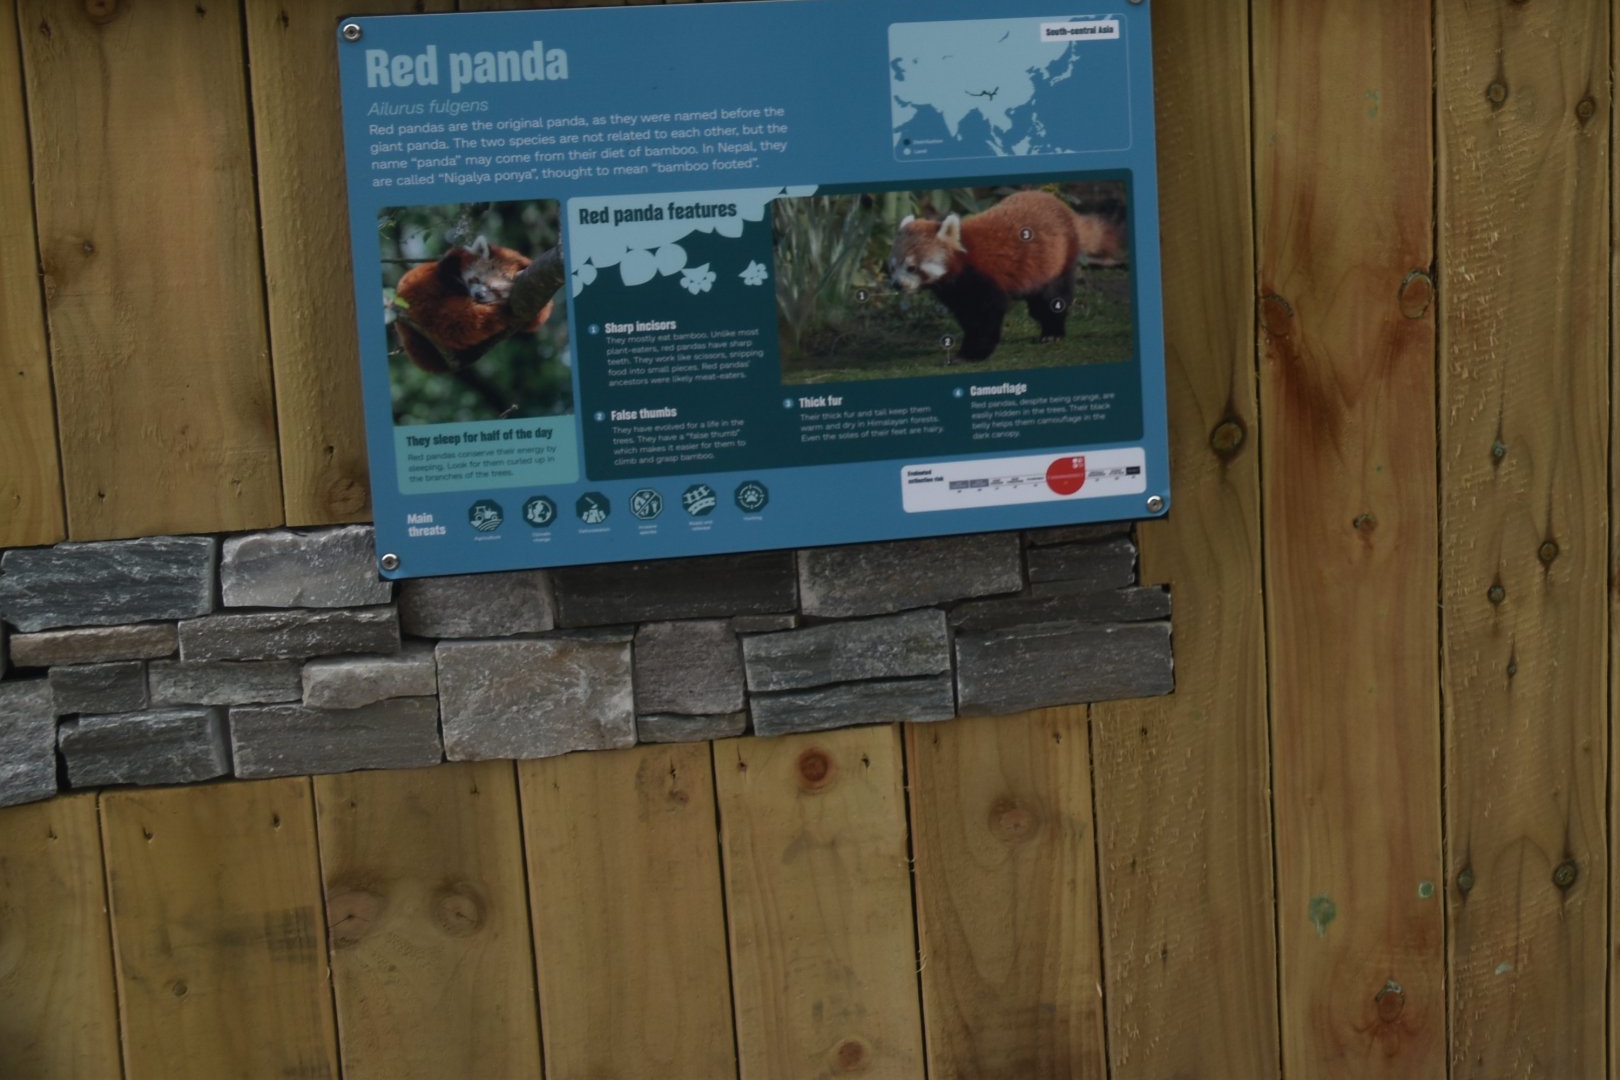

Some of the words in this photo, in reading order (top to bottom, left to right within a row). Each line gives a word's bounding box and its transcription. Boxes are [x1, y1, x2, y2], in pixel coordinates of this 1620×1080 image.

[1098, 25, 1114, 34] Asia
[364, 44, 440, 88] Red
[447, 39, 570, 94] panda
[366, 101, 424, 117] Ailurus
[429, 98, 489, 117] fulgens
[369, 124, 394, 136] Red
[398, 121, 445, 138] pandas
[448, 123, 468, 132] are
[472, 119, 493, 131] the
[497, 117, 543, 133] original
[546, 114, 589, 130] panda,
[592, 116, 606, 125] as
[610, 112, 637, 127] they
[641, 113, 671, 123] were
[674, 108, 717, 121] named
[721, 106, 760, 119] before
[764, 105, 785, 117] the
[369, 140, 403, 156] giant
[407, 138, 449, 154] panda.
[454, 137, 477, 149] The
[481, 135, 505, 148] two
[509, 133, 556, 149] species
[559, 134, 579, 144] are
[582, 131, 603, 143] not
[607, 128, 650, 142] related
[654, 128, 667, 139] to
[670, 126, 700, 138] each
[704, 124, 739, 138] other,
[742, 123, 763, 135] but
[767, 122, 788, 134] the
[371, 160, 408, 170] name
[465, 156, 492, 168] may
[495, 154, 530, 164] come
[534, 149, 564, 162] from
[568, 148, 597, 160] their
[600, 146, 624, 159] diet
[629, 146, 641, 157] of
[645, 143, 698, 156] bamboo.
[703, 142, 714, 153] In
[718, 140, 757, 155] Nepal,
[760, 138, 788, 153] they
[372, 177, 393, 187] are
[396, 173, 434, 186] called
[542, 165, 593, 181] thought
[596, 164, 609, 176] to
[613, 165, 648, 175] mean
[579, 206, 610, 225] Red
[614, 203, 664, 226] panda
[667, 198, 737, 221] features
[605, 322, 634, 336] Sharp
[636, 319, 677, 332] incisors
[607, 336, 626, 347] They
[628, 334, 656, 345] mostly
[658, 333, 671, 342] eat
[711, 329, 736, 338] Unlike
[738, 328, 760, 337] most
[661, 344, 675, 352] red
[676, 342, 706, 353] pandas
[708, 340, 727, 349] have
[730, 339, 752, 349] sharp
[634, 355, 653, 366] They
[655, 354, 674, 363] work
[678, 353, 691, 361] like
[729, 348, 765, 360] snipping
[608, 367, 627, 376] food
[629, 366, 645, 375] into
[647, 365, 669, 374] small
[701, 361, 718, 370] Red
[608, 377, 648, 387] ancestors
[673, 374, 693, 384] likely
[970, 382, 1028, 399] Camouflage
[799, 396, 826, 408] Thick
[827, 395, 843, 406] fur
[611, 409, 638, 421] False
[639, 407, 678, 419] thumbs
[406, 435, 431, 449] They
[433, 433, 461, 447] sleep
[463, 432, 478, 443] for
[480, 431, 500, 442] half
[503, 430, 513, 440] of
[516, 429, 532, 440] the
[535, 427, 553, 441] day
[407, 512, 433, 525] Main
[408, 524, 446, 538] threats
